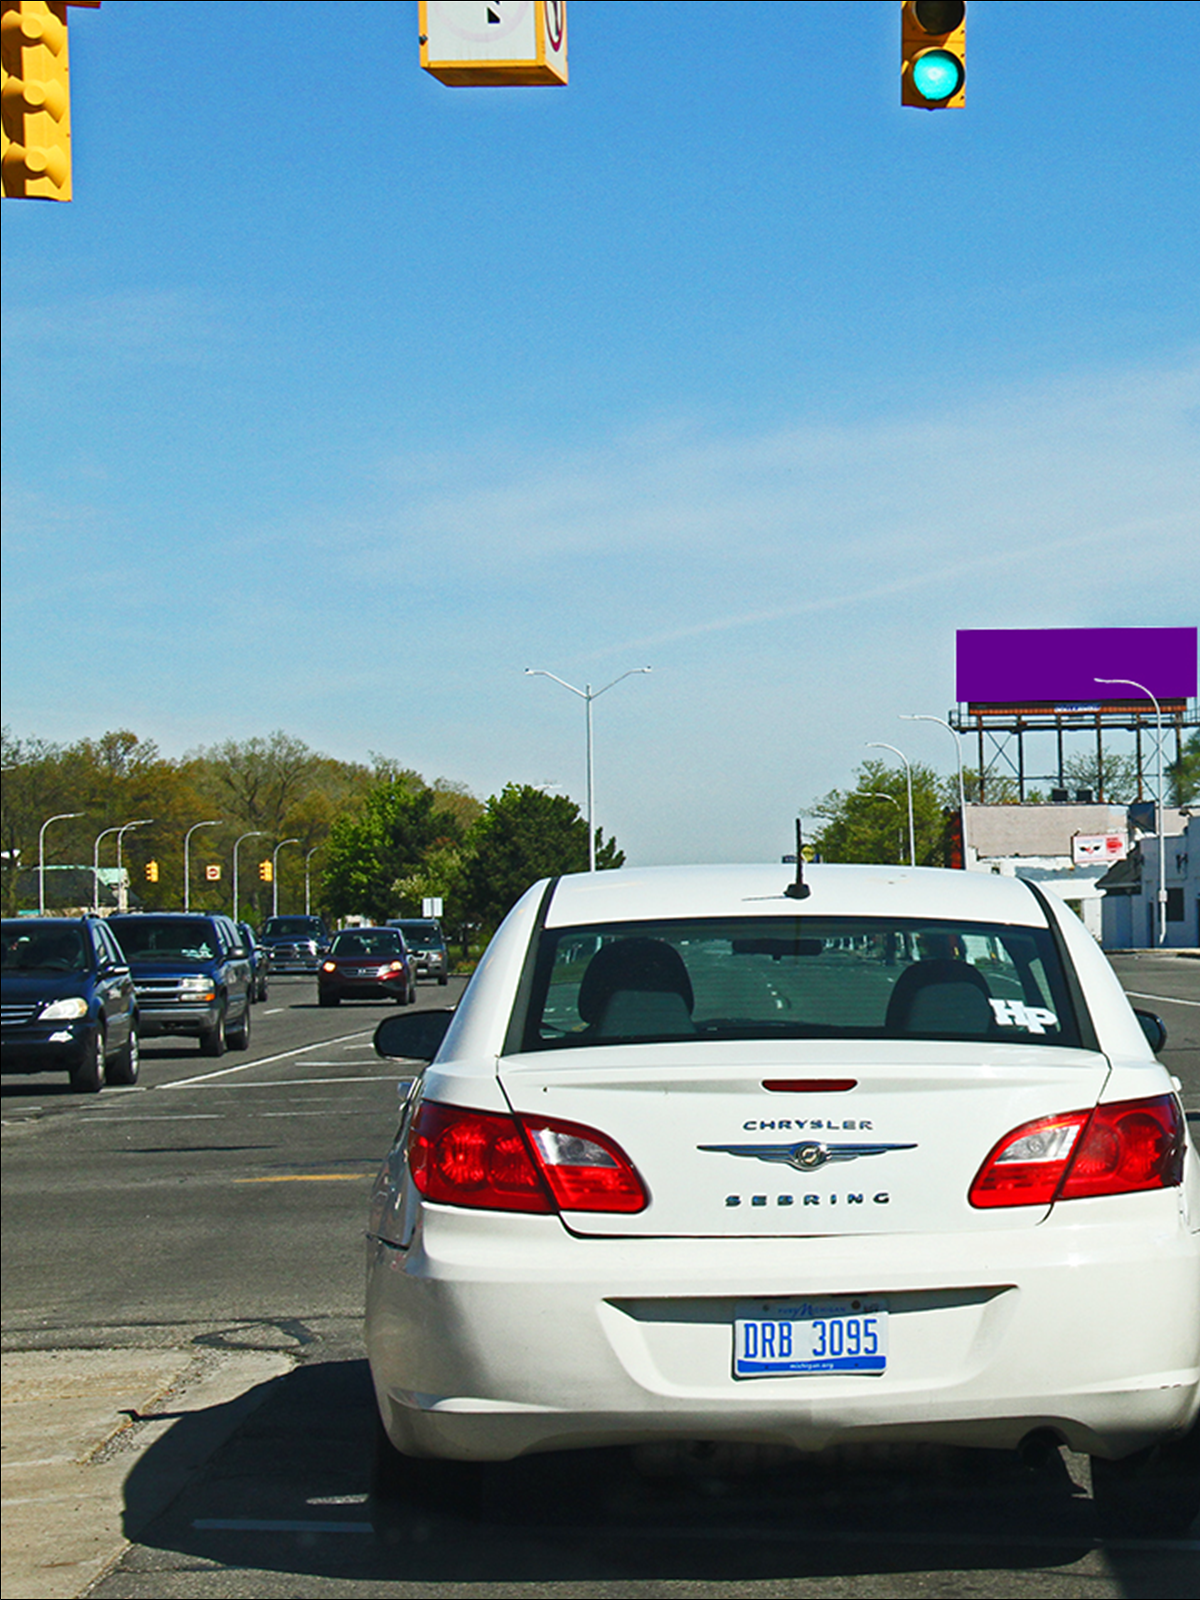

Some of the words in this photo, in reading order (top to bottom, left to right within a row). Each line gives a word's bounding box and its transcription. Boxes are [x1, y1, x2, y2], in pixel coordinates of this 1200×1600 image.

[988, 998, 1058, 1034] HP
[742, 1119, 874, 1131] CHRYSLER
[724, 1192, 891, 1208] SEBRING
[743, 1321, 793, 1358] DRB
[812, 1318, 878, 1357] 3095
